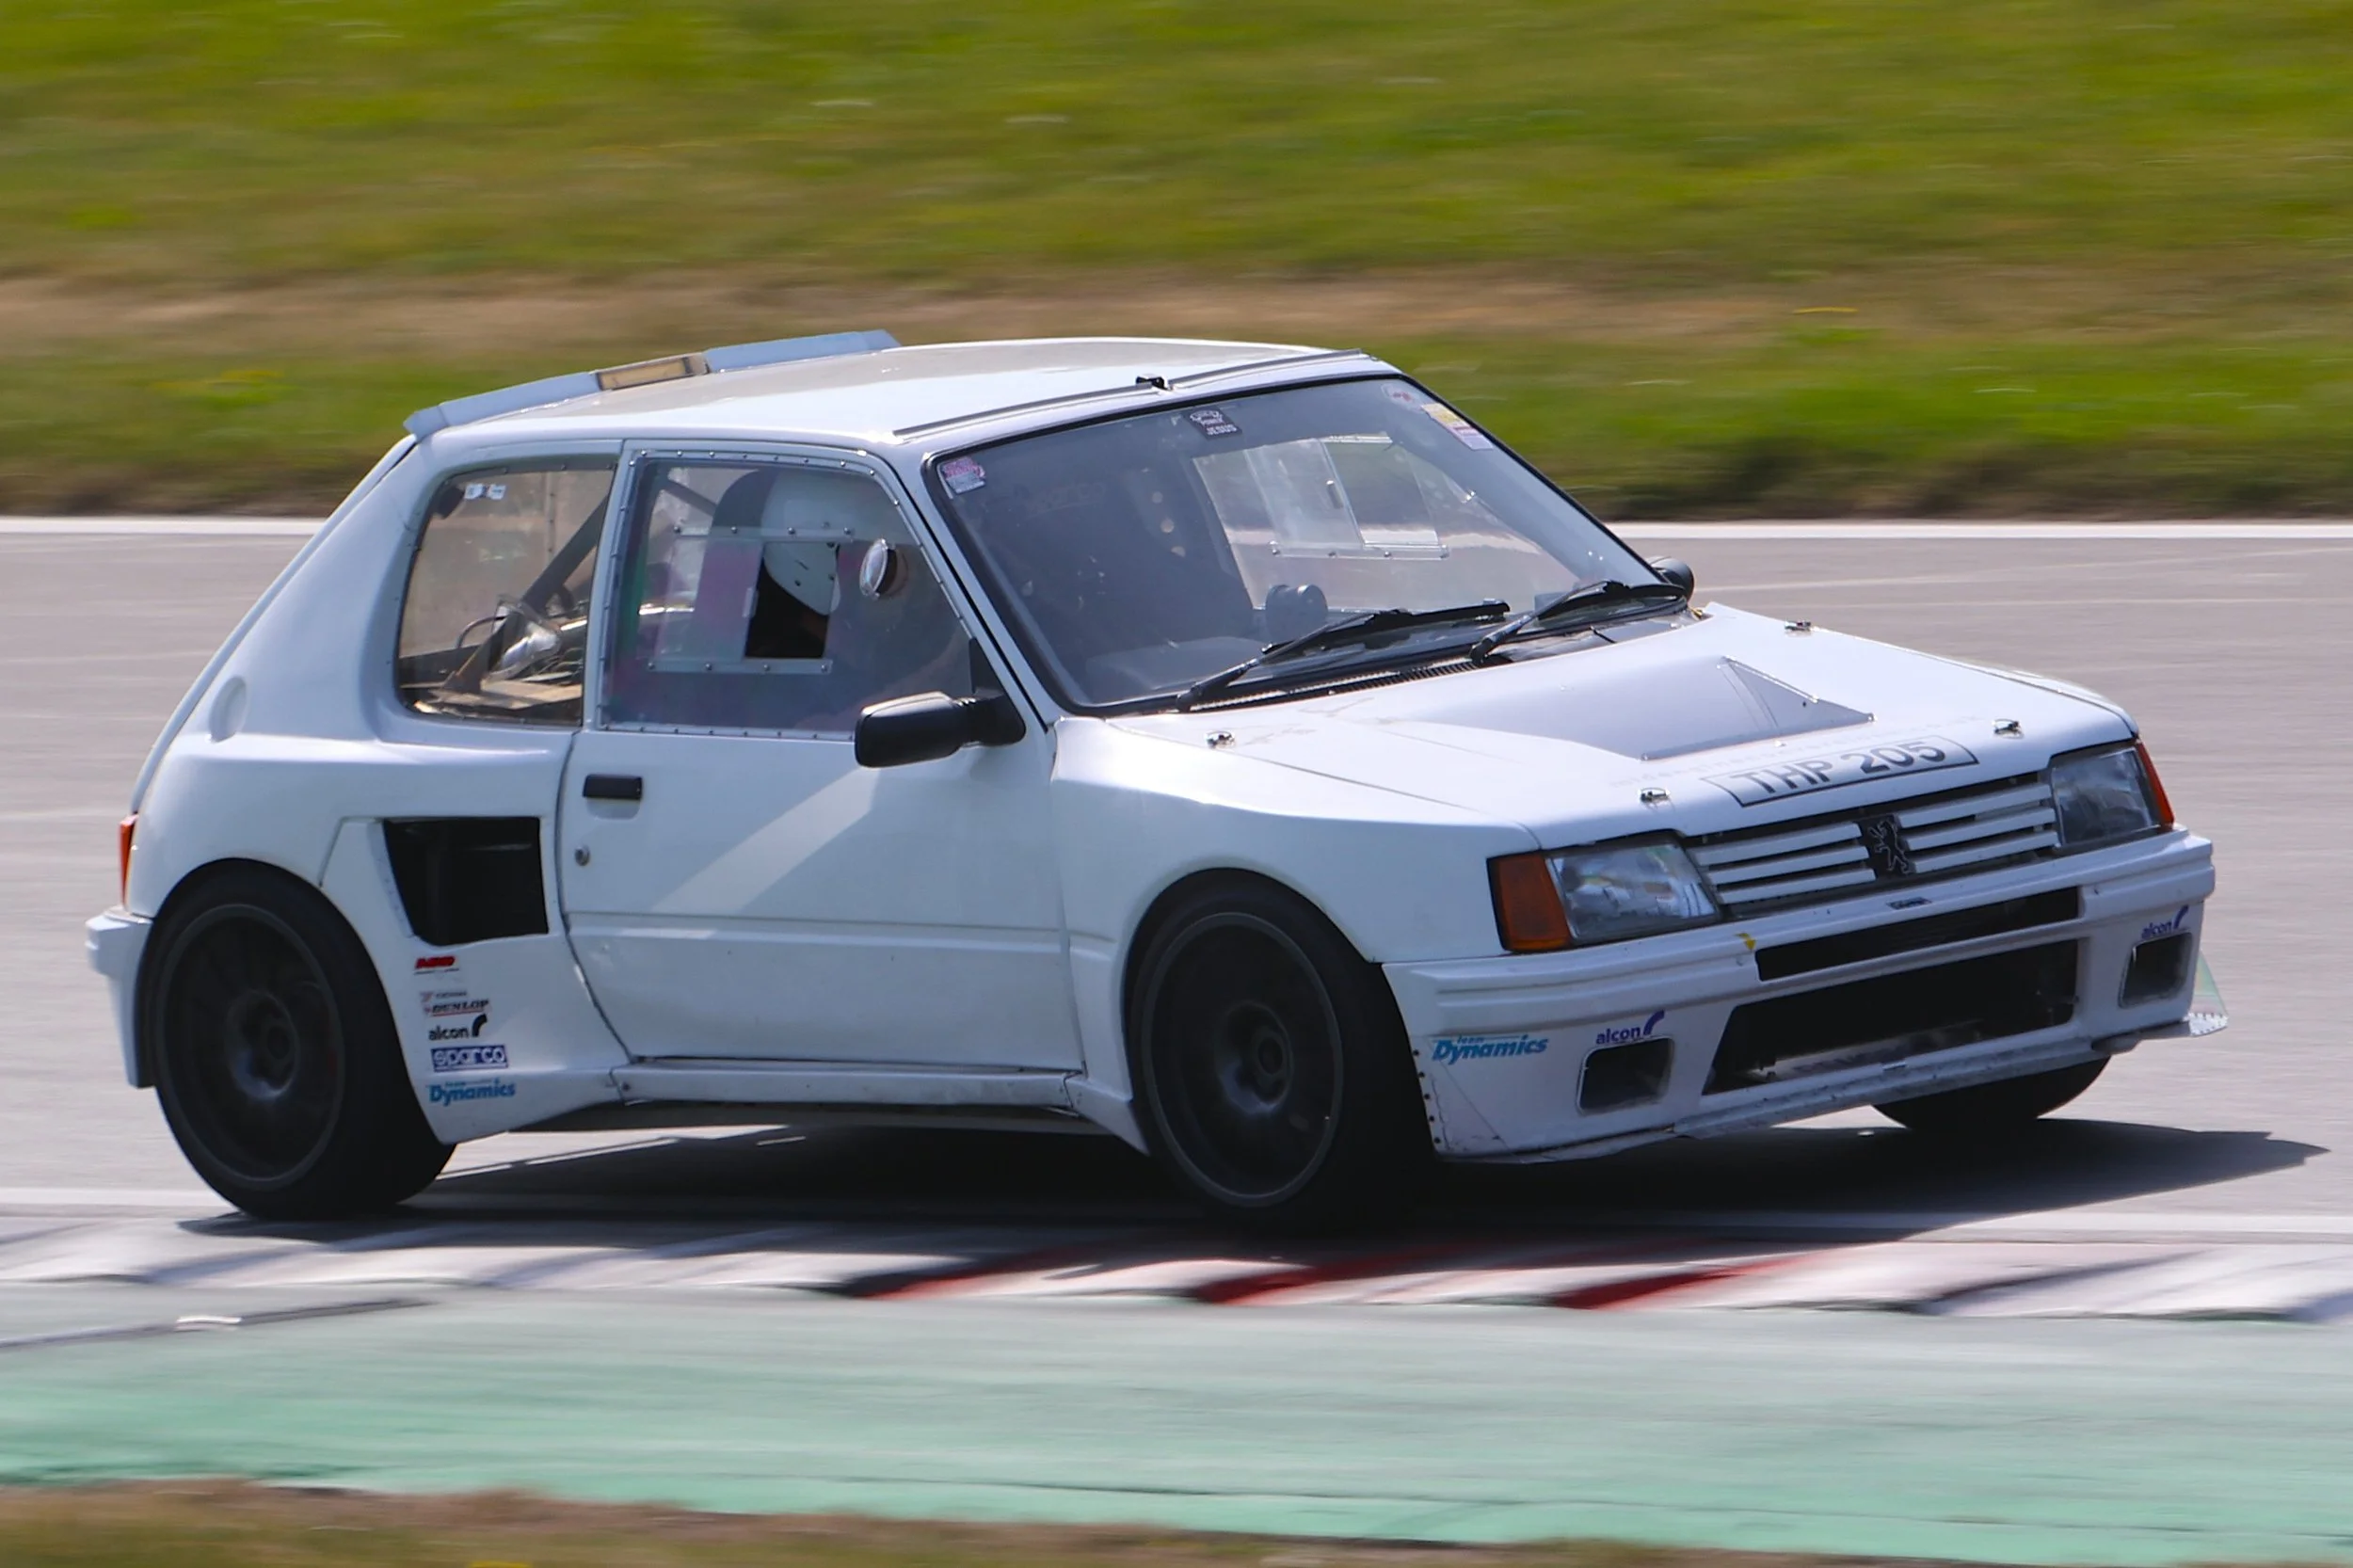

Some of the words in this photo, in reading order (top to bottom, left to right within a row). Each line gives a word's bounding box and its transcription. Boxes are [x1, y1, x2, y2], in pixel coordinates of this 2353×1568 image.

[1729, 760, 1833, 794] THP
[1841, 741, 1946, 775] 205
[428, 1025, 470, 1041] alcon
[1595, 1027, 1641, 1045] alcon
[434, 1047, 505, 1068] sparco
[1432, 1034, 1549, 1065] Dynamics
[429, 1078, 516, 1106] Dynamics
